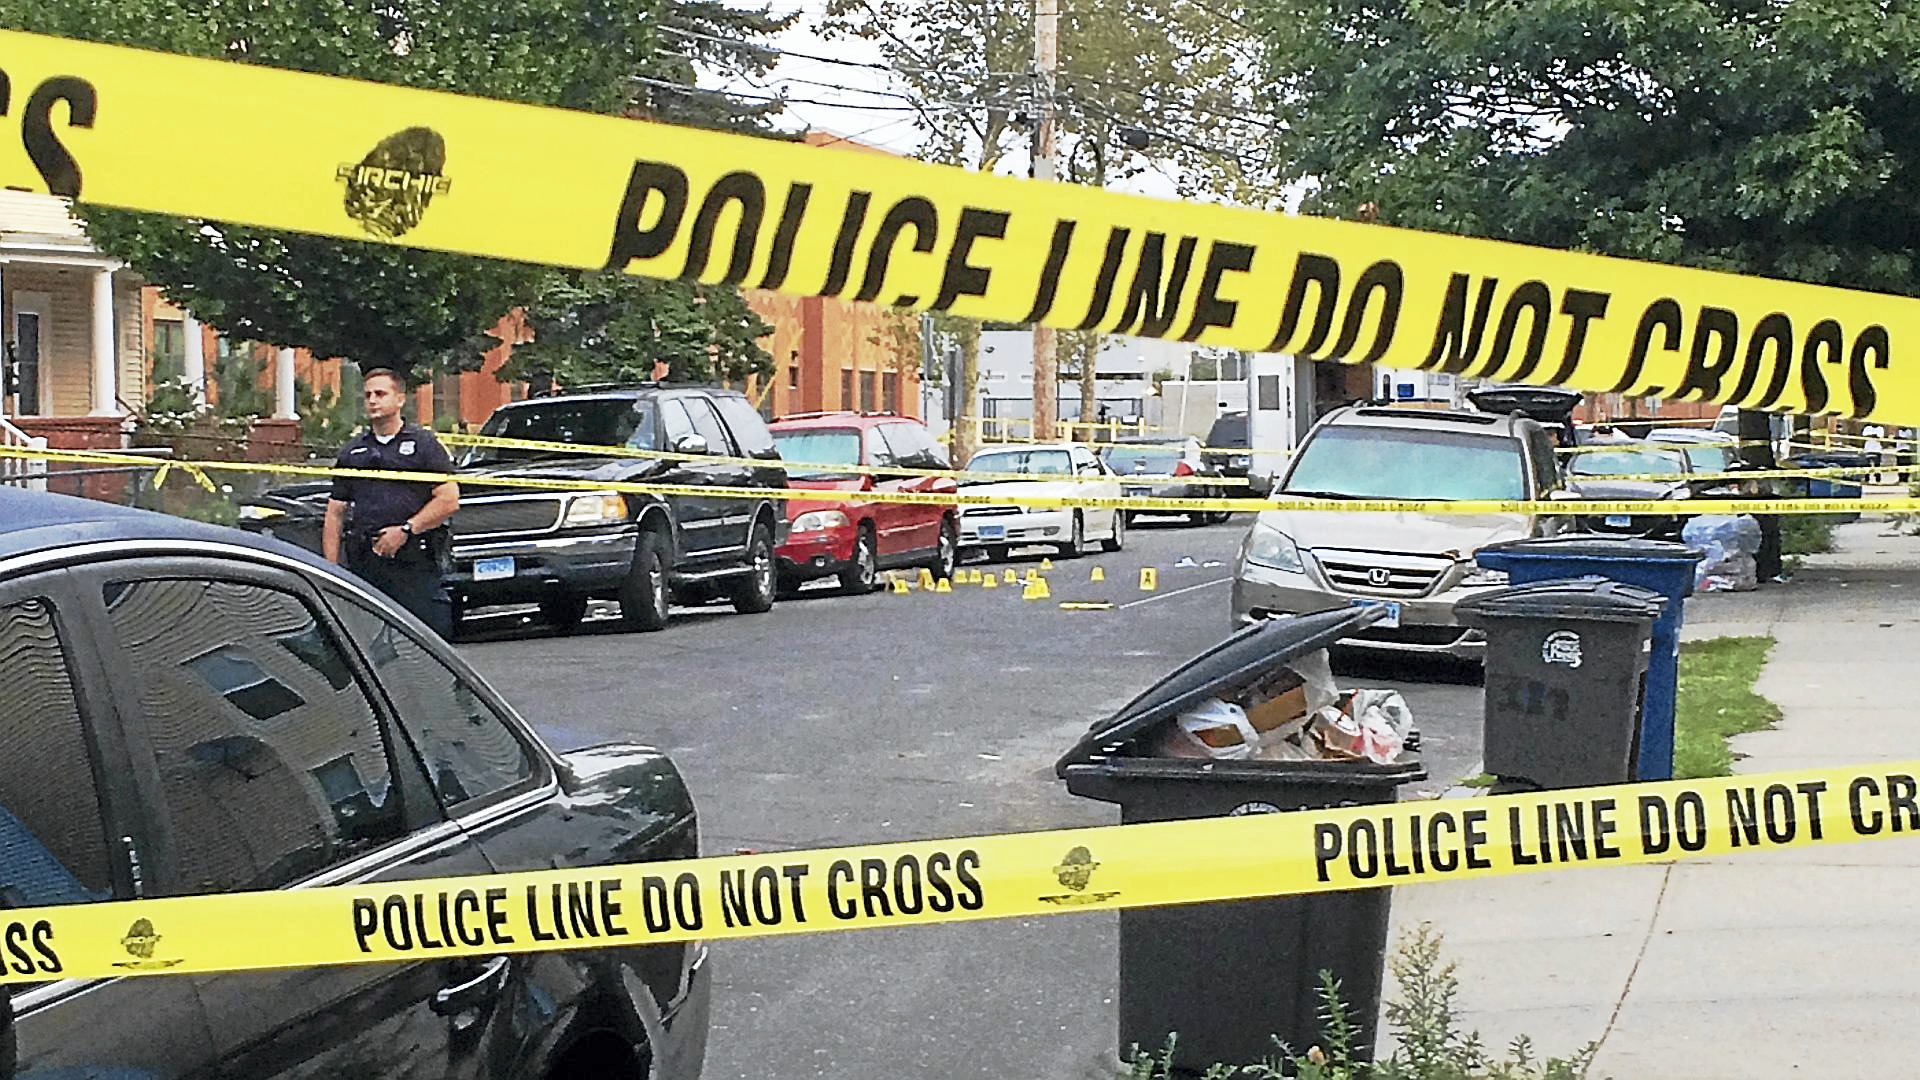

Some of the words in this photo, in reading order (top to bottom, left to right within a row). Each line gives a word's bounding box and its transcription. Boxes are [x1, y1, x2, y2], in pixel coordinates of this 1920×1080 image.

[0, 68, 97, 198] S
[606, 160, 1012, 311] POLICE
[1026, 219, 1257, 341] LINE
[1268, 251, 1404, 362] DO
[1420, 272, 1613, 386] NOT
[1612, 297, 1892, 421] CROSS
[1315, 810, 1492, 883] POLICE
[1508, 799, 1622, 867] LINE
[1638, 791, 1707, 856] DO
[1726, 780, 1828, 848] NOT
[0, 919, 63, 976] SS
[353, 886, 515, 952] POLICE
[526, 879, 629, 943] LINE
[641, 873, 703, 934] DO
[720, 864, 810, 928] NOT
[827, 850, 984, 921] CROSS
